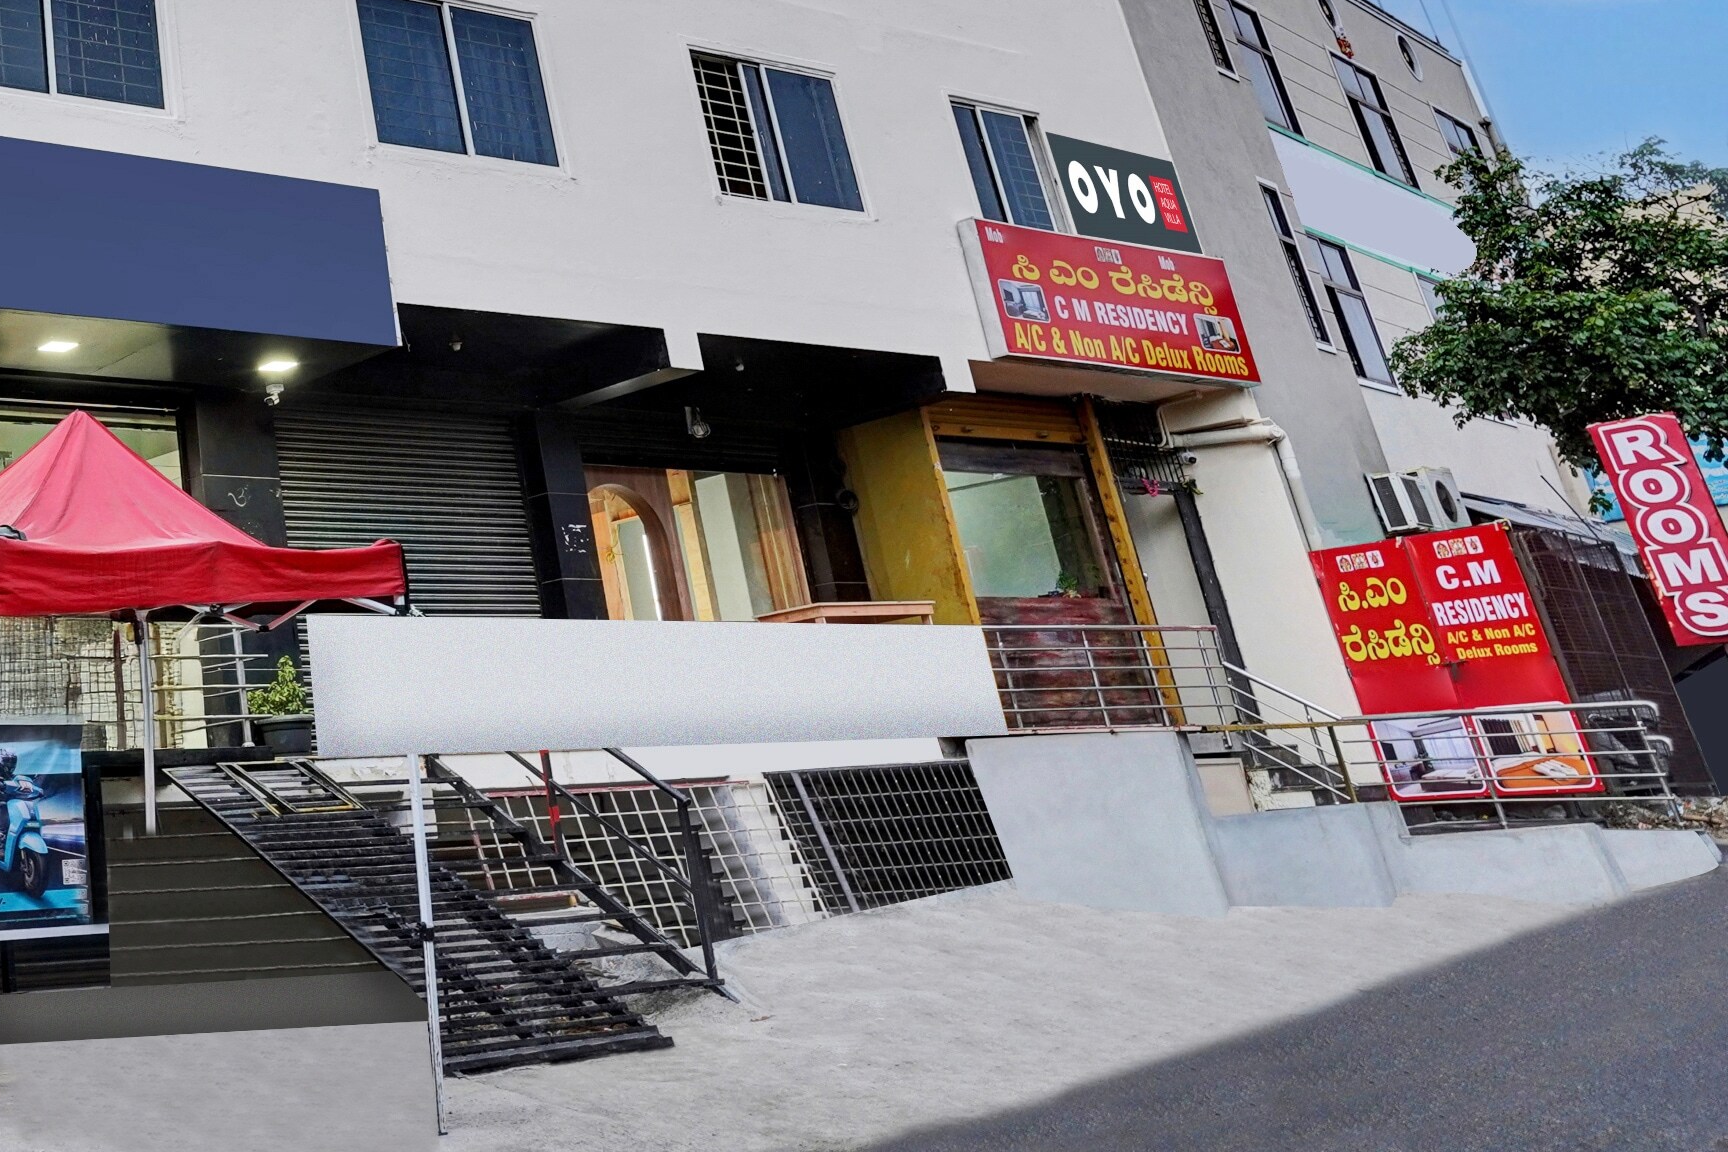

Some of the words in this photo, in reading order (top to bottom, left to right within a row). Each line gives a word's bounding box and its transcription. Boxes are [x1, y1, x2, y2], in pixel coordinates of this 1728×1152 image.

[1068, 160, 1156, 224] OYO
[1153, 181, 1173, 195] HOTEL
[1160, 197, 1177, 210] AQUA
[1164, 212, 1181, 225] VILLA
[985, 226, 1004, 243] Mob
[1012, 254, 1041, 280] ಸಿ
[1049, 260, 1100, 290] ಎಂ
[1158, 255, 1175, 271] Mob
[1054, 295, 1069, 319] C
[1071, 298, 1092, 322] M
[1093, 301, 1188, 335] RESIDENCY
[1014, 322, 1046, 353] A/C
[1051, 327, 1068, 354] &
[1069, 329, 1106, 359] Non
[1109, 335, 1140, 364] A/C
[1141, 339, 1192, 369] Delux
[1191, 345, 1249, 376] Rooms
[1609, 428, 1728, 628] ROOMS
[1435, 559, 1502, 589] C.M
[1432, 592, 1529, 626] RESIDENCY
[1447, 630, 1469, 645] A/C
[1472, 629, 1483, 641] &
[1484, 628, 1511, 640] Non
[1513, 623, 1536, 638] A/C
[1456, 646, 1493, 659] Delux
[1494, 642, 1538, 656] Rooms
